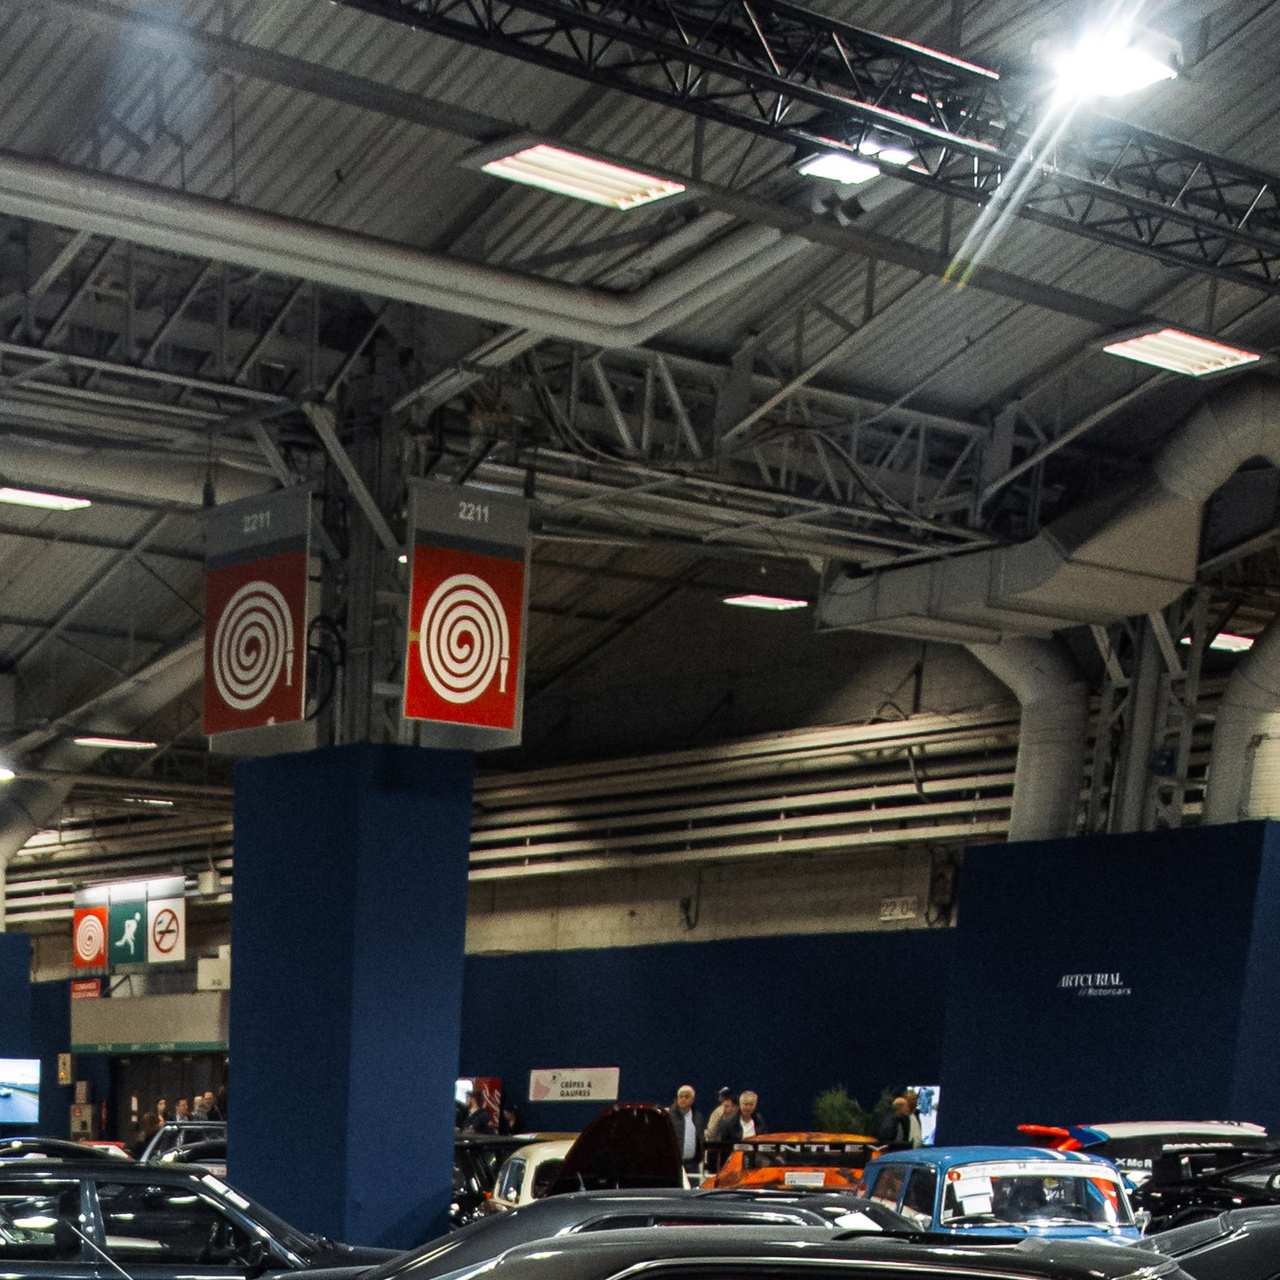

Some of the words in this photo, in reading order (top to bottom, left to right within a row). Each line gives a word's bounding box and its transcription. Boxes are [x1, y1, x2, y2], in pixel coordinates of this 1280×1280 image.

[459, 502, 489, 523] 2211
[241, 511, 270, 533] 2211
[1057, 973, 1123, 988] ARTCURIAL
[733, 1144, 888, 1152] BENTLEY
